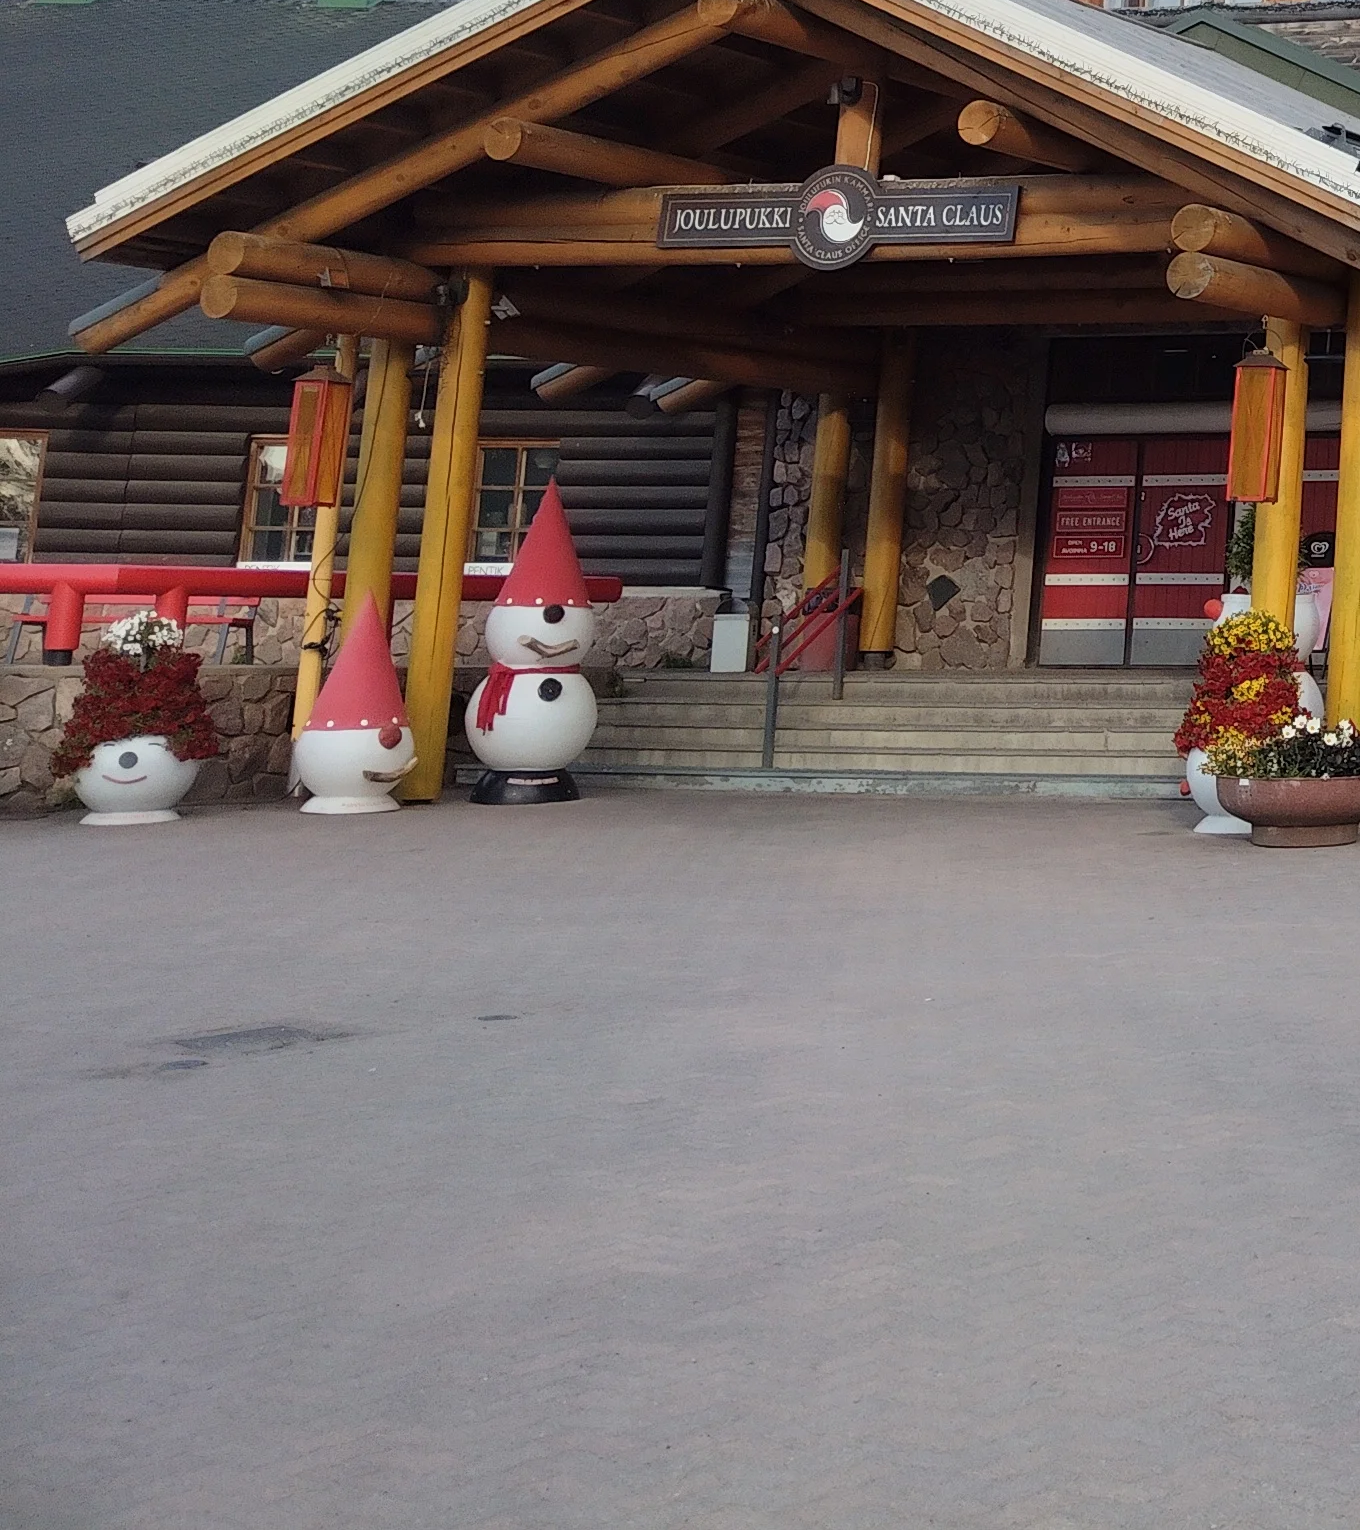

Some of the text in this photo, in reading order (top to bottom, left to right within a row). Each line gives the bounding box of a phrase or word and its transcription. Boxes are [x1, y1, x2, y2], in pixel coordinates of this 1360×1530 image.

[673, 206, 792, 233] JOULUPUKKI
[875, 203, 1004, 228] SANTA CLAUS
[797, 225, 871, 259] SANTA CLAUS OFFICE
[1167, 501, 1201, 521] Santa
[1061, 516, 1121, 527] FREE ENTRANCE
[1168, 525, 1195, 541] Here
[1089, 541, 1117, 553] 9-18
